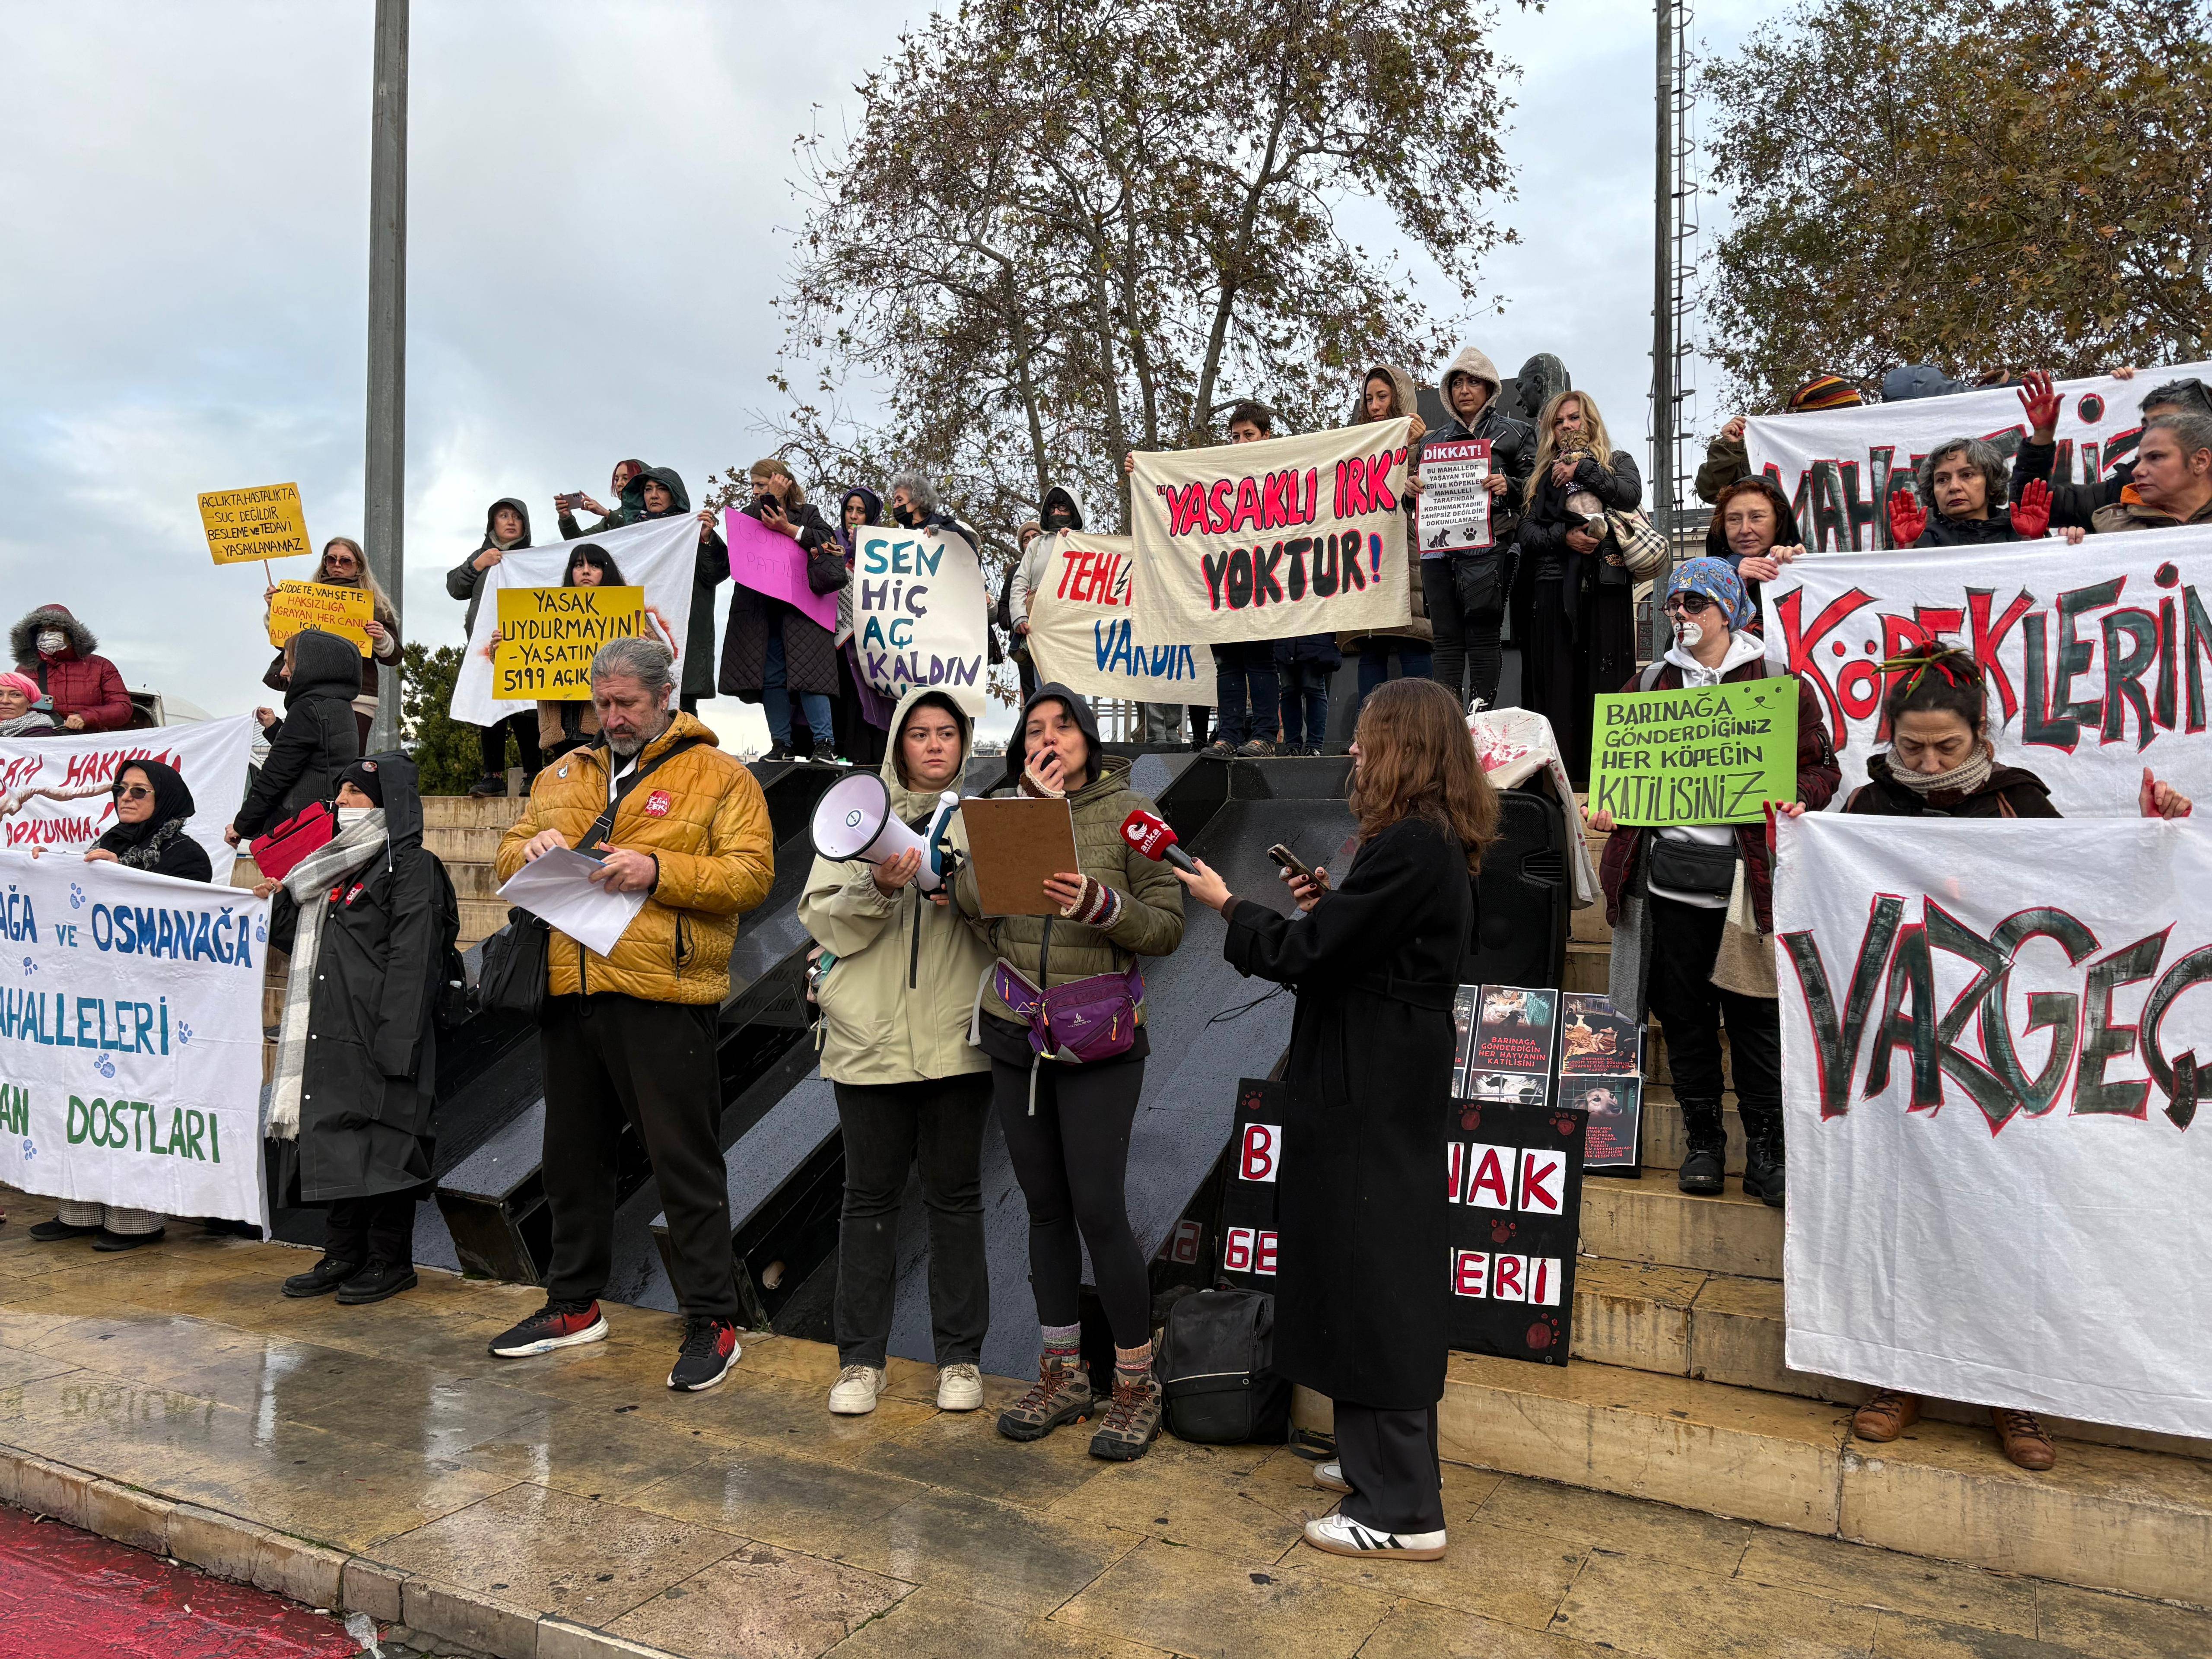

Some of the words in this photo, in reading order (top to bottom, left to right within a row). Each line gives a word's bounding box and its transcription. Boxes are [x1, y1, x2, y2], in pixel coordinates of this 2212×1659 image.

[1424, 445, 1481, 460] DİKKAT!
[1437, 464, 1479, 473] MAHALLEDE
[1433, 495, 1475, 504] TARAFINDAN
[1435, 487, 1472, 496] MAHALLELİ
[215, 512, 235, 522] SUÇ
[240, 505, 279, 522] DEĞİLDİR
[1421, 511, 1451, 519] SAHİPSİZ
[1453, 508, 1485, 517] DEĞİLDİR!
[1424, 501, 1483, 512] KORUNMAKTADIR!
[207, 526, 248, 540] BESLEME
[259, 517, 292, 534] TEDAVİ
[1426, 516, 1479, 526] DOKUNULAMAZ!
[222, 538, 303, 556] YASAKLANAMAZ
[864, 539, 945, 577] SEN
[1201, 529, 1383, 612] YOKTUR!
[272, 605, 312, 620] UĞRAYAN
[318, 613, 335, 624] HER
[288, 596, 346, 613] HAKSIZLIĞA
[533, 590, 600, 616] YASAK
[502, 610, 641, 642] UYDURMAYIN!
[863, 616, 914, 649] AÇ
[504, 668, 545, 691] 5199
[866, 651, 982, 686] KALDIN
[1606, 692, 1733, 726] BARINAĞA
[1605, 717, 1772, 748] GÖNDERDİĞİNİZ
[1601, 750, 1651, 769] HER
[1661, 741, 1763, 768] KÖPEĞİN
[1599, 771, 1768, 821] KATİLİSİNİZ
[6, 802, 114, 847] DOKUNMA!
[1141, 828, 1160, 852] anka
[55, 924, 78, 948] VE
[92, 903, 252, 968] OSMANAĞA
[1481, 1043, 1541, 1053] GÖNDERDİĞİN
[1500, 1052, 1546, 1061] HAYVANIN
[67, 1095, 220, 1163] DOSTLARI
